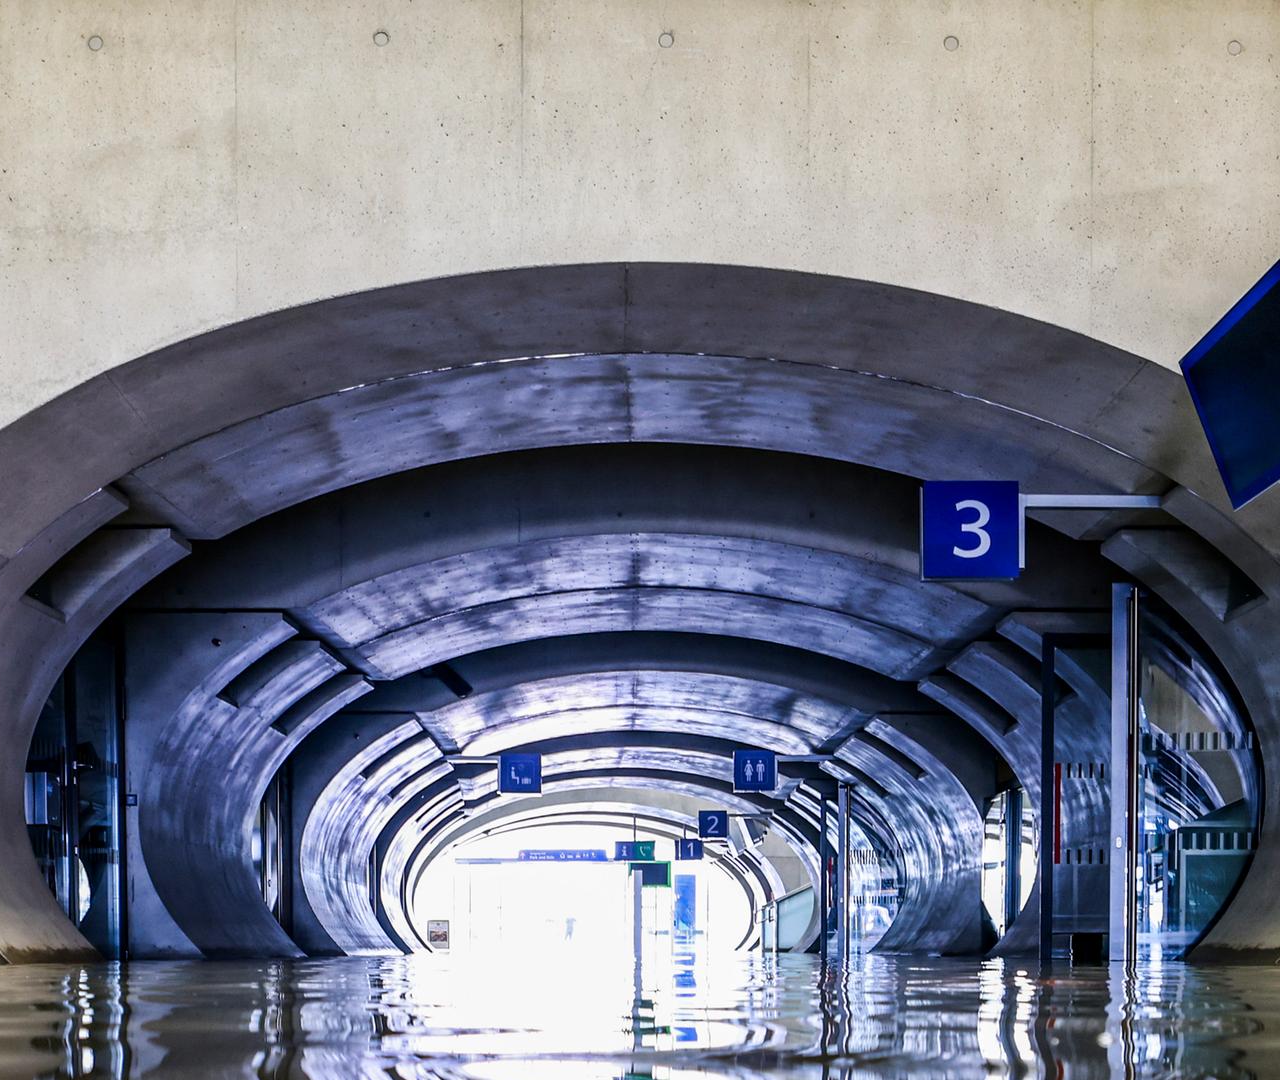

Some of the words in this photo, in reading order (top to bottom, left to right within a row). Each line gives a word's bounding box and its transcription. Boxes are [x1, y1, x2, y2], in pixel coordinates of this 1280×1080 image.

[953, 499, 991, 559] 3
[707, 816, 719, 834] 2
[687, 842, 694, 857] 1
